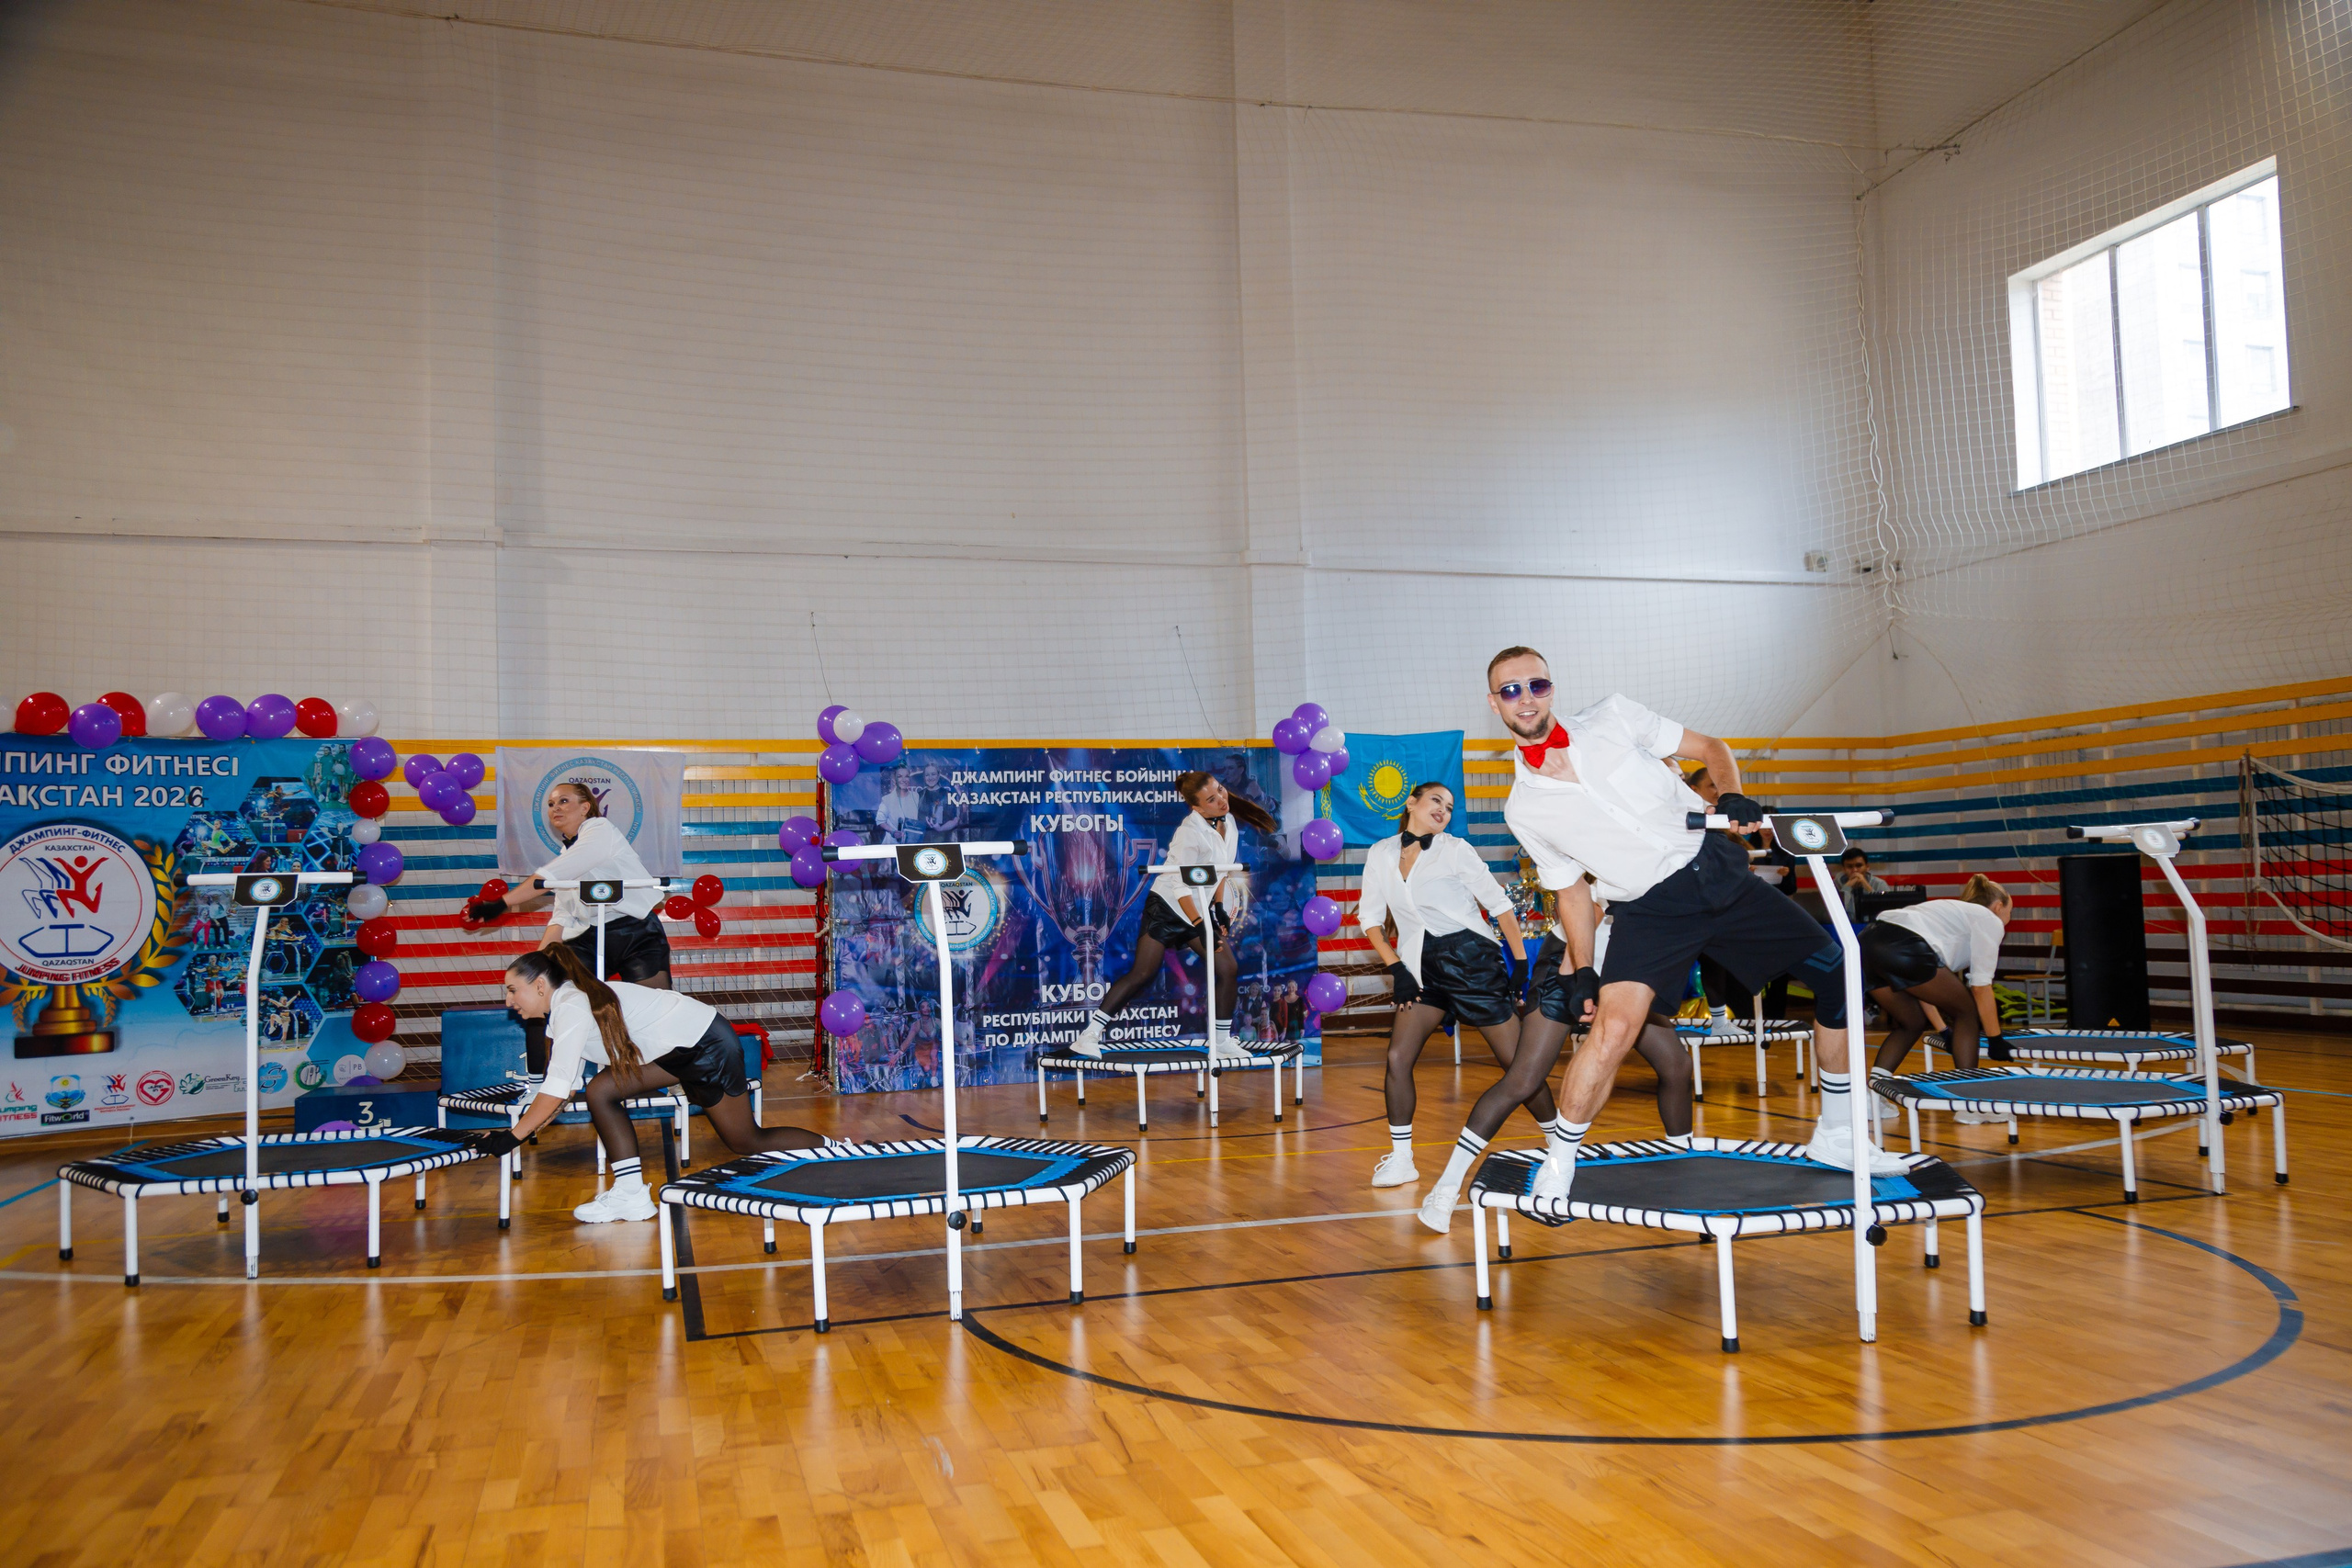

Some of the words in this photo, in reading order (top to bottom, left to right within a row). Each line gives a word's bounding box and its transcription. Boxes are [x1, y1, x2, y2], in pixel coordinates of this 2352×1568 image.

[0, 751, 96, 775] ПИНГ
[105, 753, 239, 777] ФИТНЕСІ
[950, 770, 1046, 786] ДЖАМПИНГ
[1049, 769, 1113, 784] ФИТНЕС
[1116, 768, 1194, 783] БОЙЫН
[134, 786, 206, 807] 2026
[947, 791, 1041, 807] ҚАЗАҚСТАН
[1030, 814, 1124, 833] КУБОГЫ
[15, 964, 71, 982] JUMPING
[72, 957, 121, 981] FITNESS
[42, 958, 95, 966] QAZAQSTAN
[1041, 982, 1112, 1003] КУБО
[982, 1010, 1085, 1028] РЕСПУБЛИКИ
[1089, 1006, 1179, 1023] ЗАХСТАН
[985, 1033, 1010, 1047] ПО
[1013, 1027, 1107, 1048] ДЖАМПГ
[1109, 1024, 1182, 1041] ФИТНЕСУ
[358, 1101, 374, 1124] 3
